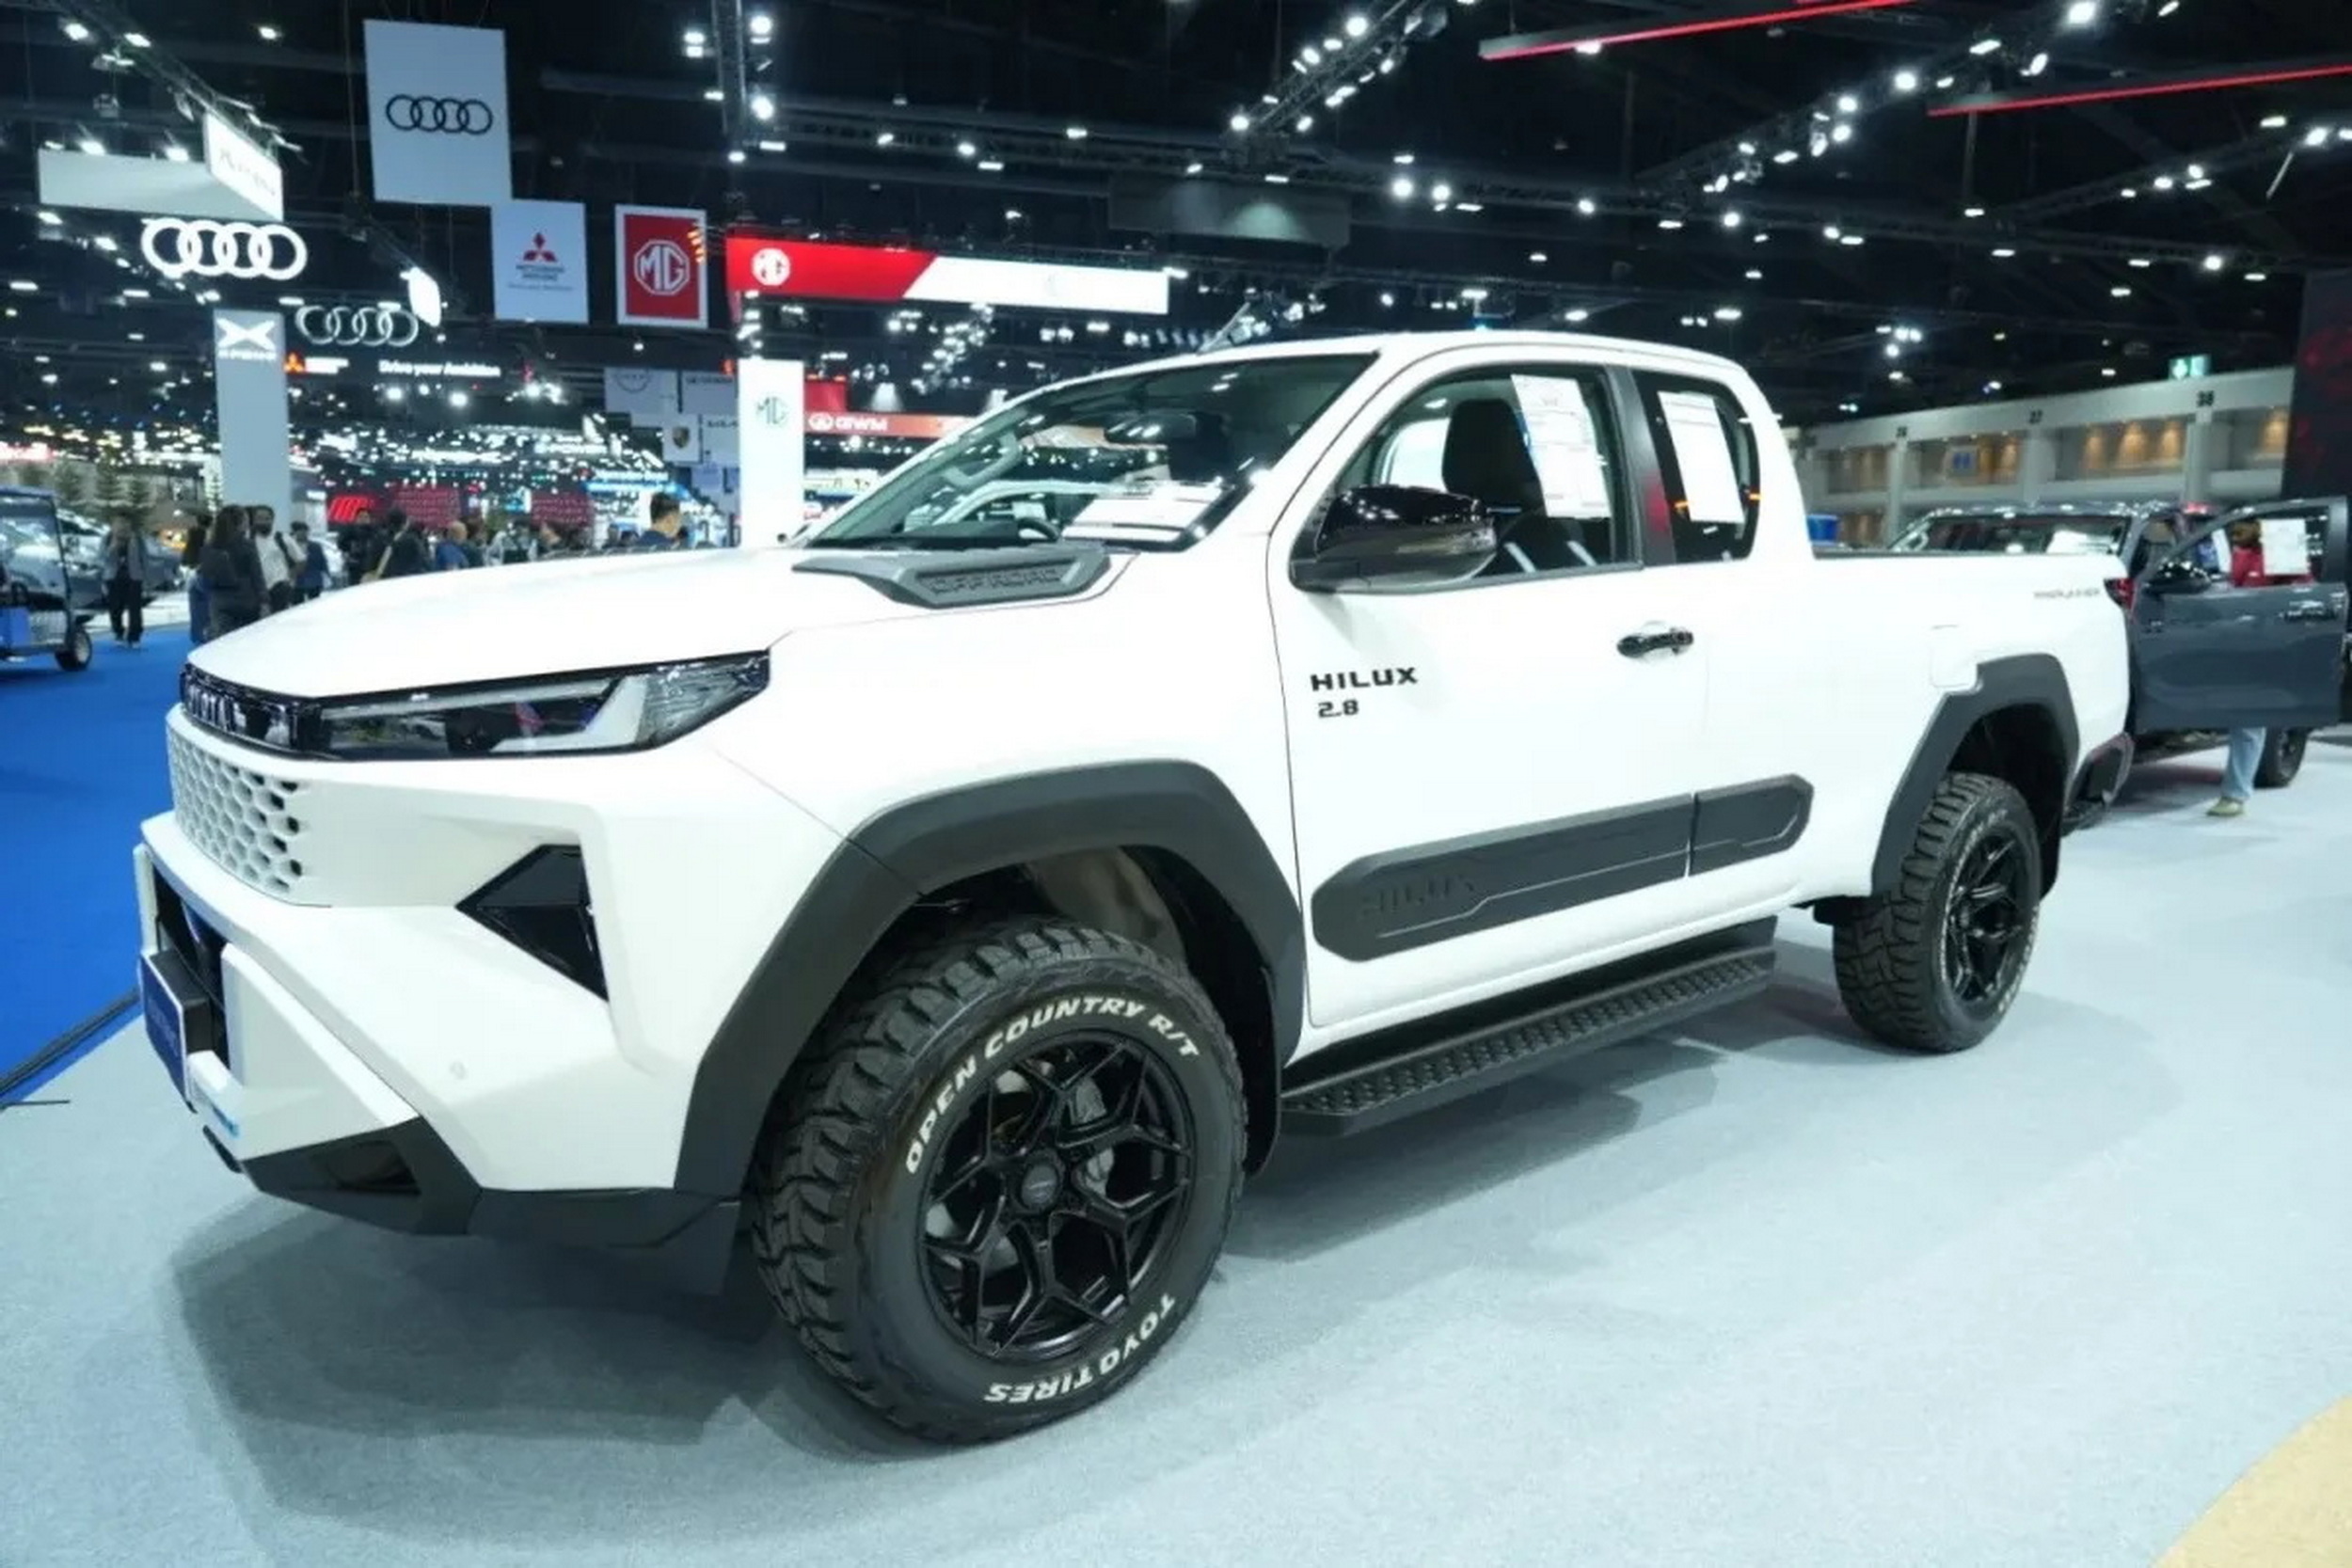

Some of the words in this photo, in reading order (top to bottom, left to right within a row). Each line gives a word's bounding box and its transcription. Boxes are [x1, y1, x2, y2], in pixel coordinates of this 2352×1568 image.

[638, 243, 687, 293] MG
[1311, 667, 1418, 691] HILUX
[1318, 699, 1359, 718] 2.8
[906, 1054, 977, 1174] OPEN
[985, 995, 1145, 1059] COUNTRY
[1149, 1013, 1200, 1056] R/T
[1100, 1292, 1175, 1374] TOYO
[984, 1366, 1093, 1402] TIRES
